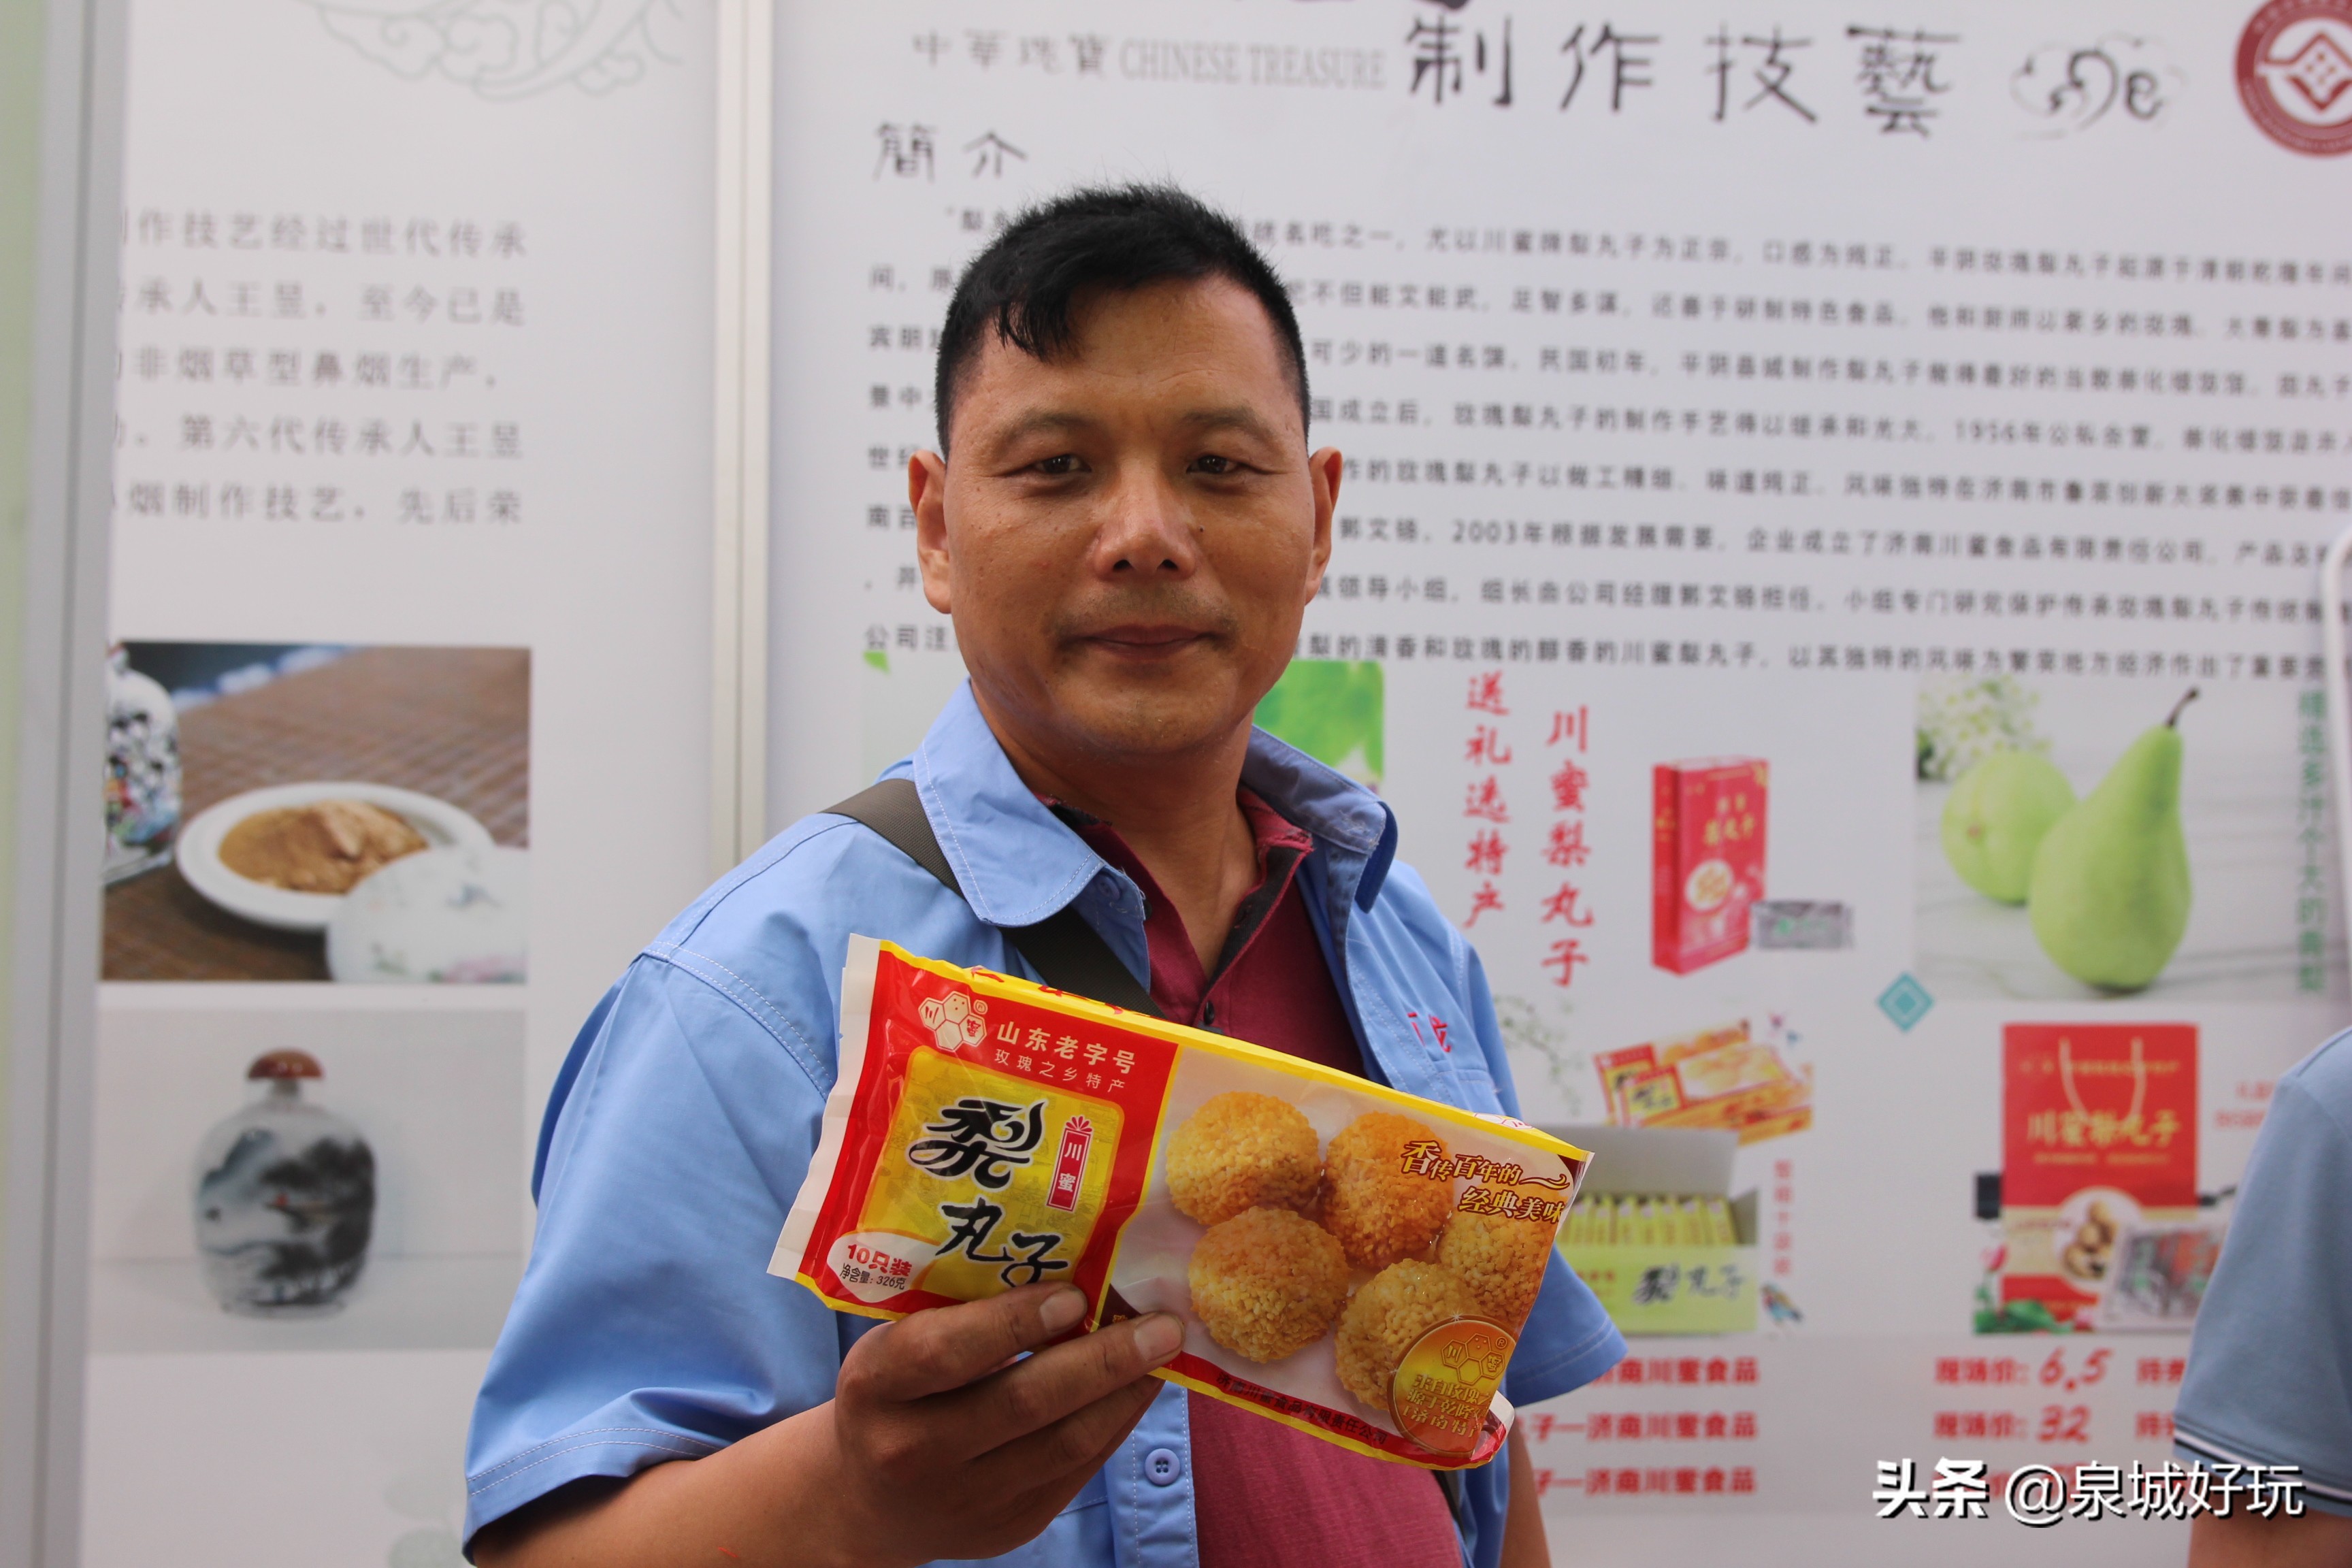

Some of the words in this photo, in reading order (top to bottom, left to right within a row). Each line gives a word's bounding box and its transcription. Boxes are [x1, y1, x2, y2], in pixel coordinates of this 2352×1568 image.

[1119, 39, 1241, 84] CHINESE
[1250, 44, 1388, 91] TREASURE
[872, 120, 1028, 183] 簡介
[120, 208, 527, 258] 作技艺经过世代传承
[116, 278, 526, 326] 承人王昱，至今已是
[116, 346, 497, 391] 非烟草型鼻烟生产，
[114, 414, 523, 459] 。第六代传承人王昱
[110, 480, 523, 525] 烟制作技艺，先后荣
[1463, 670, 1512, 929] 送礼选特产
[1541, 705, 1594, 987] 川蜜梨丸子
[995, 1048, 1125, 1094] 玫瑰之乡特产
[997, 1022, 1136, 1075] 山东老字号
[1058, 1142, 1083, 1193] 川蜜
[1400, 1140, 1524, 1186] 香传百年的
[1457, 1185, 1567, 1224] 经典美味
[847, 1243, 913, 1277] 10只装
[2038, 1347, 2114, 1392] 6.5
[1215, 1371, 1389, 1445] 济南川蜜食品有限责任公司
[2036, 1404, 2093, 1443] 32
